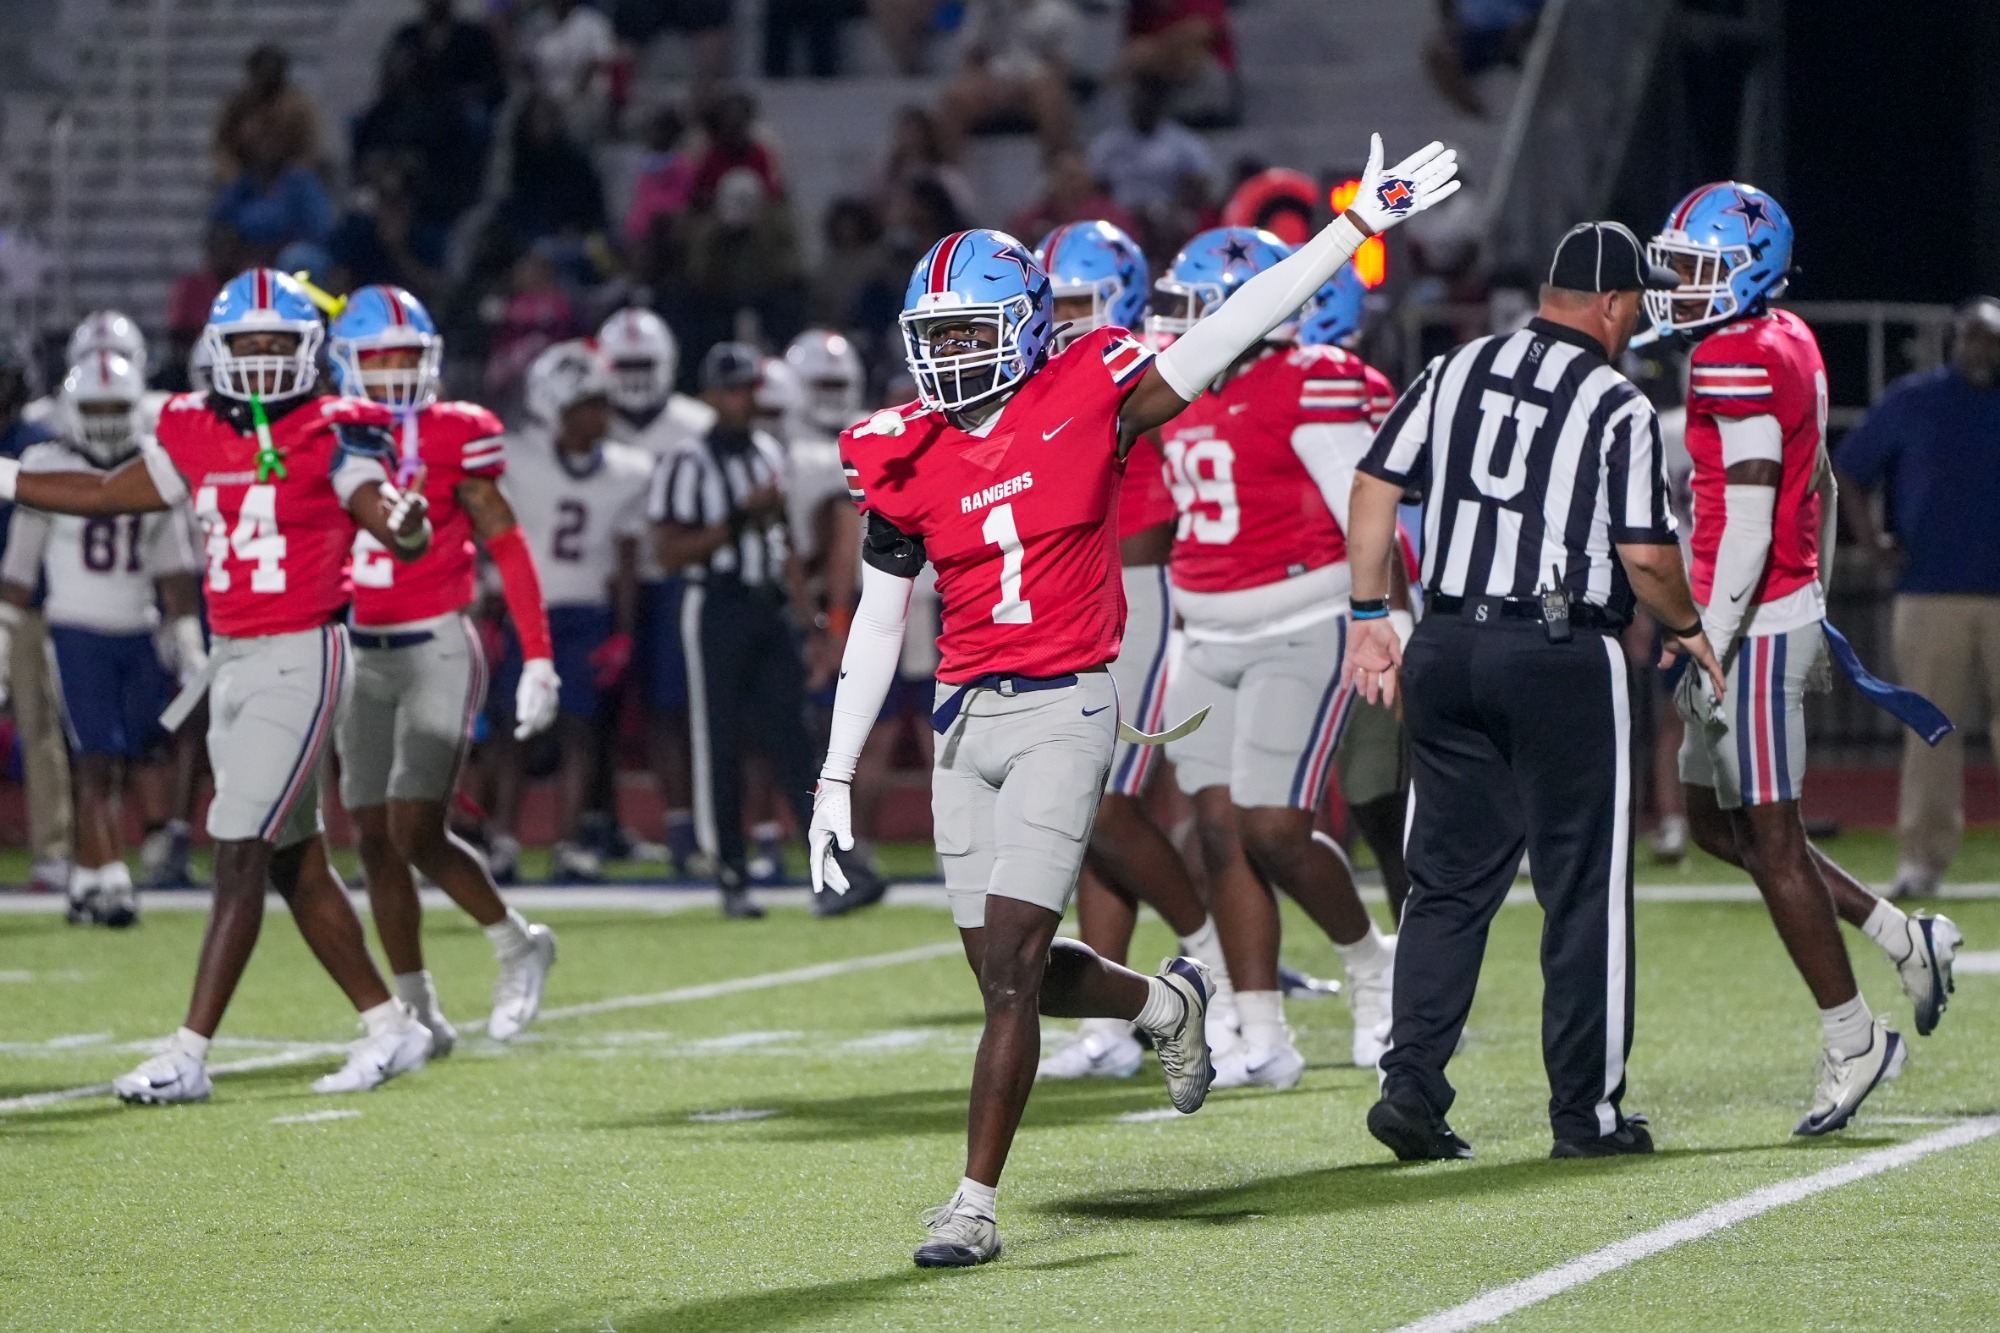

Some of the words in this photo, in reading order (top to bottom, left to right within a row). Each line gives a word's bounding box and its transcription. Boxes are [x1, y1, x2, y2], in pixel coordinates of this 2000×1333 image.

[956, 340, 978, 349] ME
[1470, 388, 1548, 500] U
[961, 471, 1034, 514] RANGERS
[83, 515, 142, 573] 81
[197, 485, 287, 593] 44
[552, 499, 587, 562] 2
[981, 502, 1033, 624] 1
